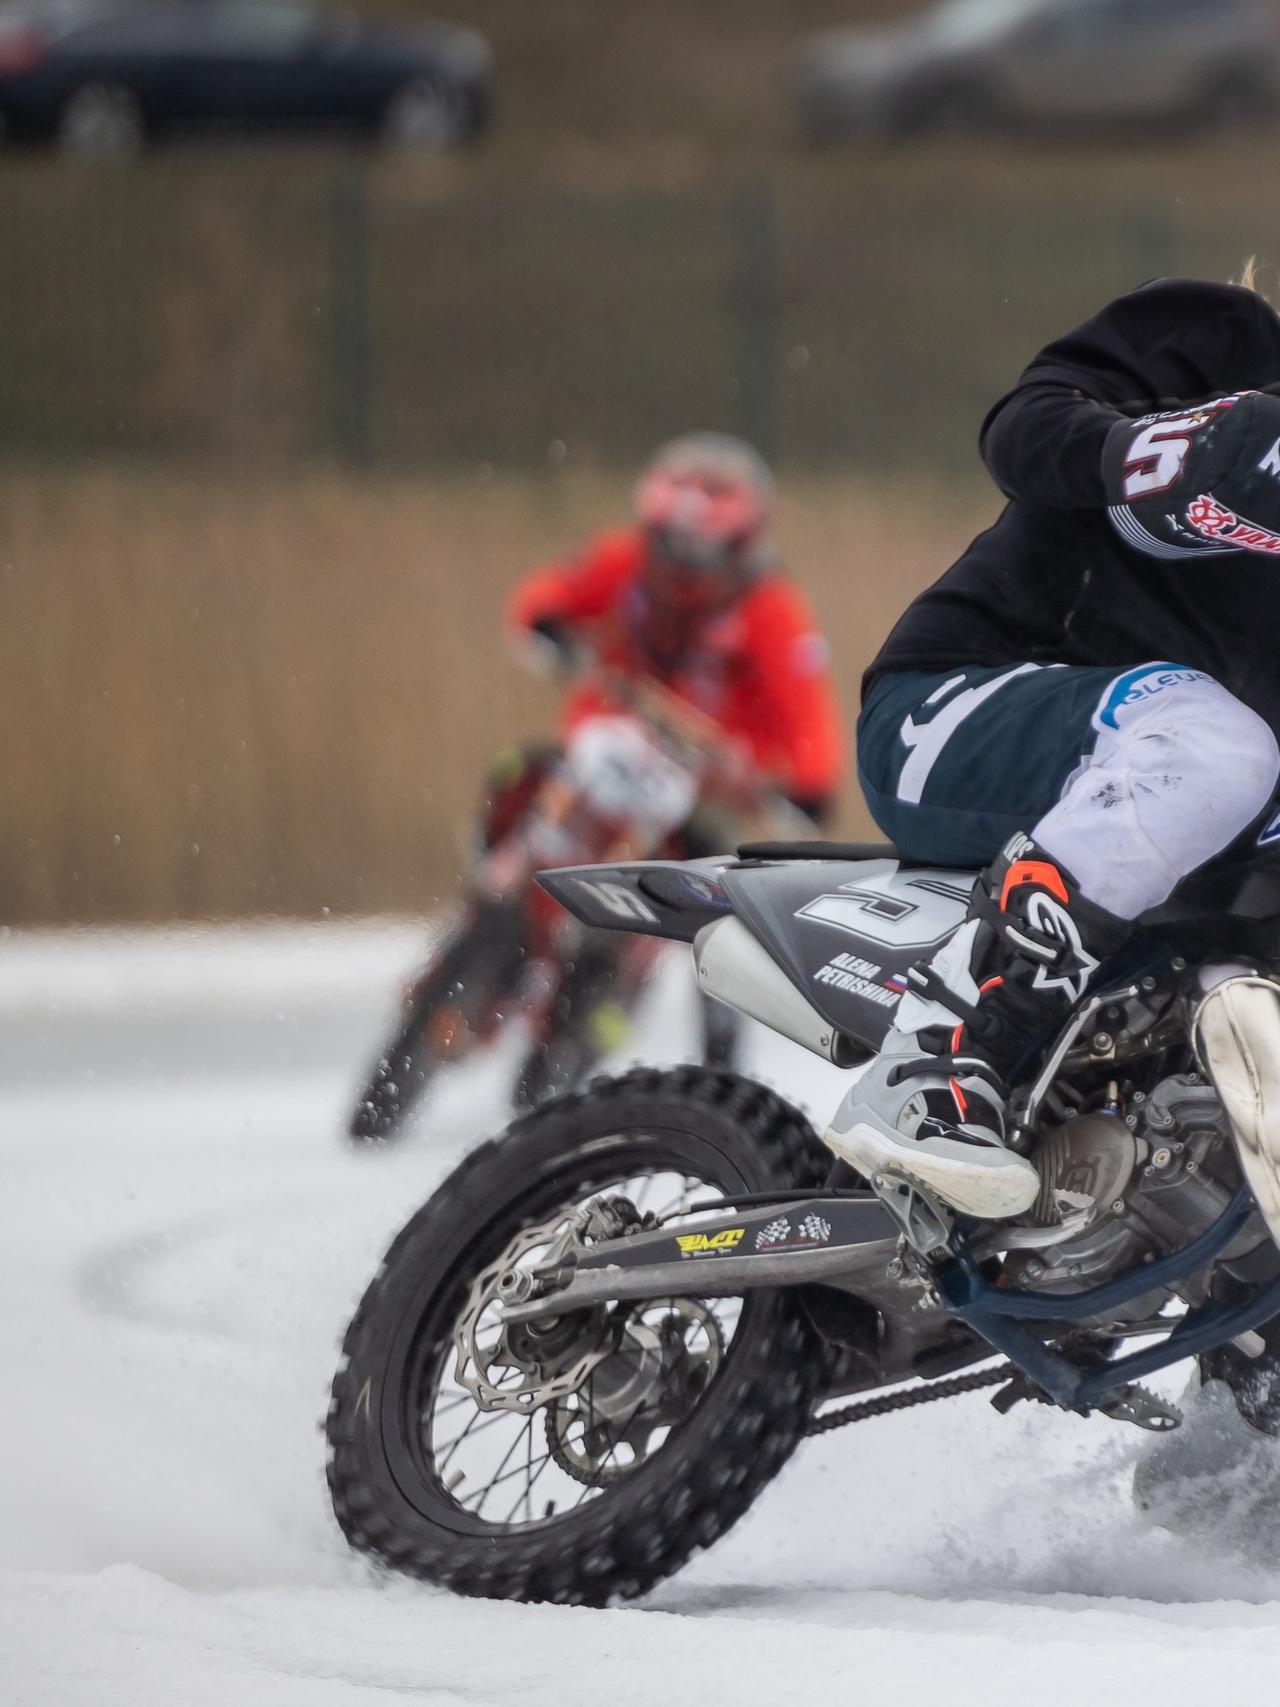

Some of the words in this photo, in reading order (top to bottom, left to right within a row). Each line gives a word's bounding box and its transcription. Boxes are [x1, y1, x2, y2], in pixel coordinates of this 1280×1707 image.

[1122, 411, 1217, 500] 5
[813, 965, 902, 1008] PETRISHINA
[829, 952, 882, 979] ALENA
